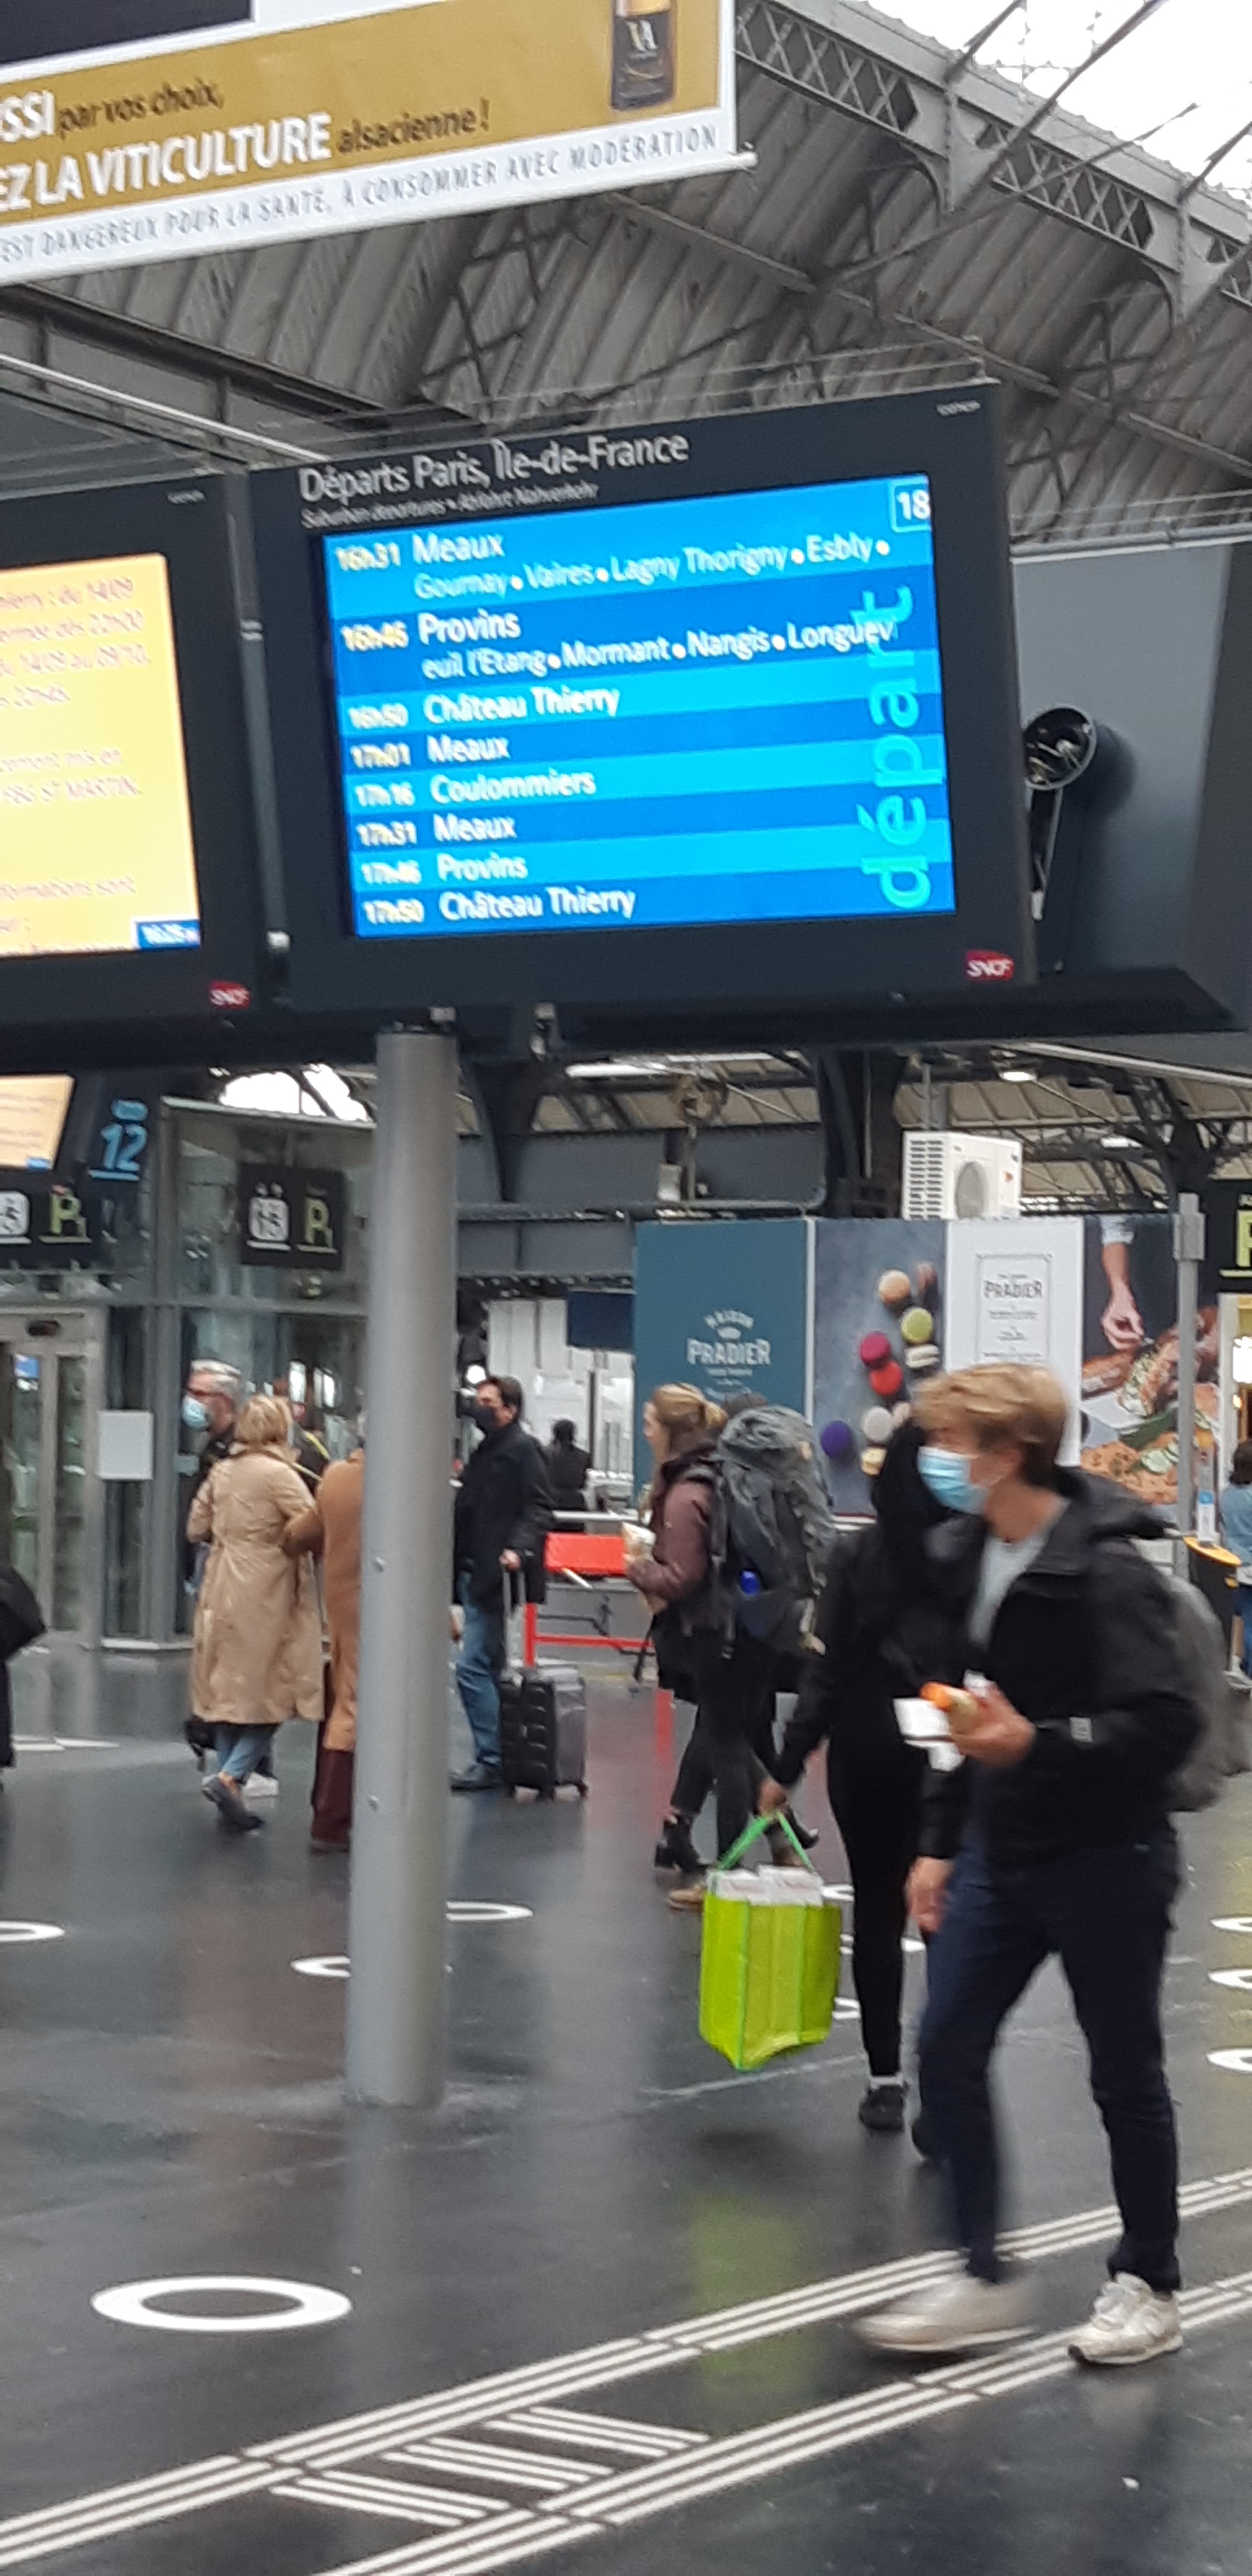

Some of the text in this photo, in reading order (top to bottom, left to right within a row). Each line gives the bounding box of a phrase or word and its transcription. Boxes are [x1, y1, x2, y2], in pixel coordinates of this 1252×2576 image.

[0, 89, 54, 143] SSI
[58, 101, 101, 141] par
[104, 94, 146, 124] vos
[35, 155, 84, 206] LA
[86, 112, 332, 196] VITICULTURE
[42, 215, 158, 256] DANGEREUX
[167, 202, 219, 235] POUR
[225, 200, 251, 228] LA
[362, 160, 497, 205] CONSOMMER
[506, 149, 559, 181] AVEC
[298, 434, 690, 506] Départs Paris, Île-de-France
[896, 489, 931, 520] 18
[336, 532, 505, 571] 16h31 Meaux
[414, 531, 873, 600] Gournay Vaires Lagny Thorigny Esbly
[417, 608, 521, 645] Provins
[421, 650, 466, 679] euil
[561, 635, 671, 668] Mormant
[686, 624, 770, 661] Nangis
[423, 692, 527, 724] Château
[530, 684, 620, 718] Thierry
[426, 733, 511, 763] Meaux
[851, 585, 945, 908] départ
[430, 767, 597, 804] Coulommiers
[433, 812, 517, 842] Meaux
[437, 851, 529, 882] Provins
[439, 890, 543, 921] Château
[544, 885, 636, 920] Thierry
[967, 959, 1012, 977] SNCF
[101, 1123, 148, 1172] 12
[687, 1337, 771, 1366] PRADIER
